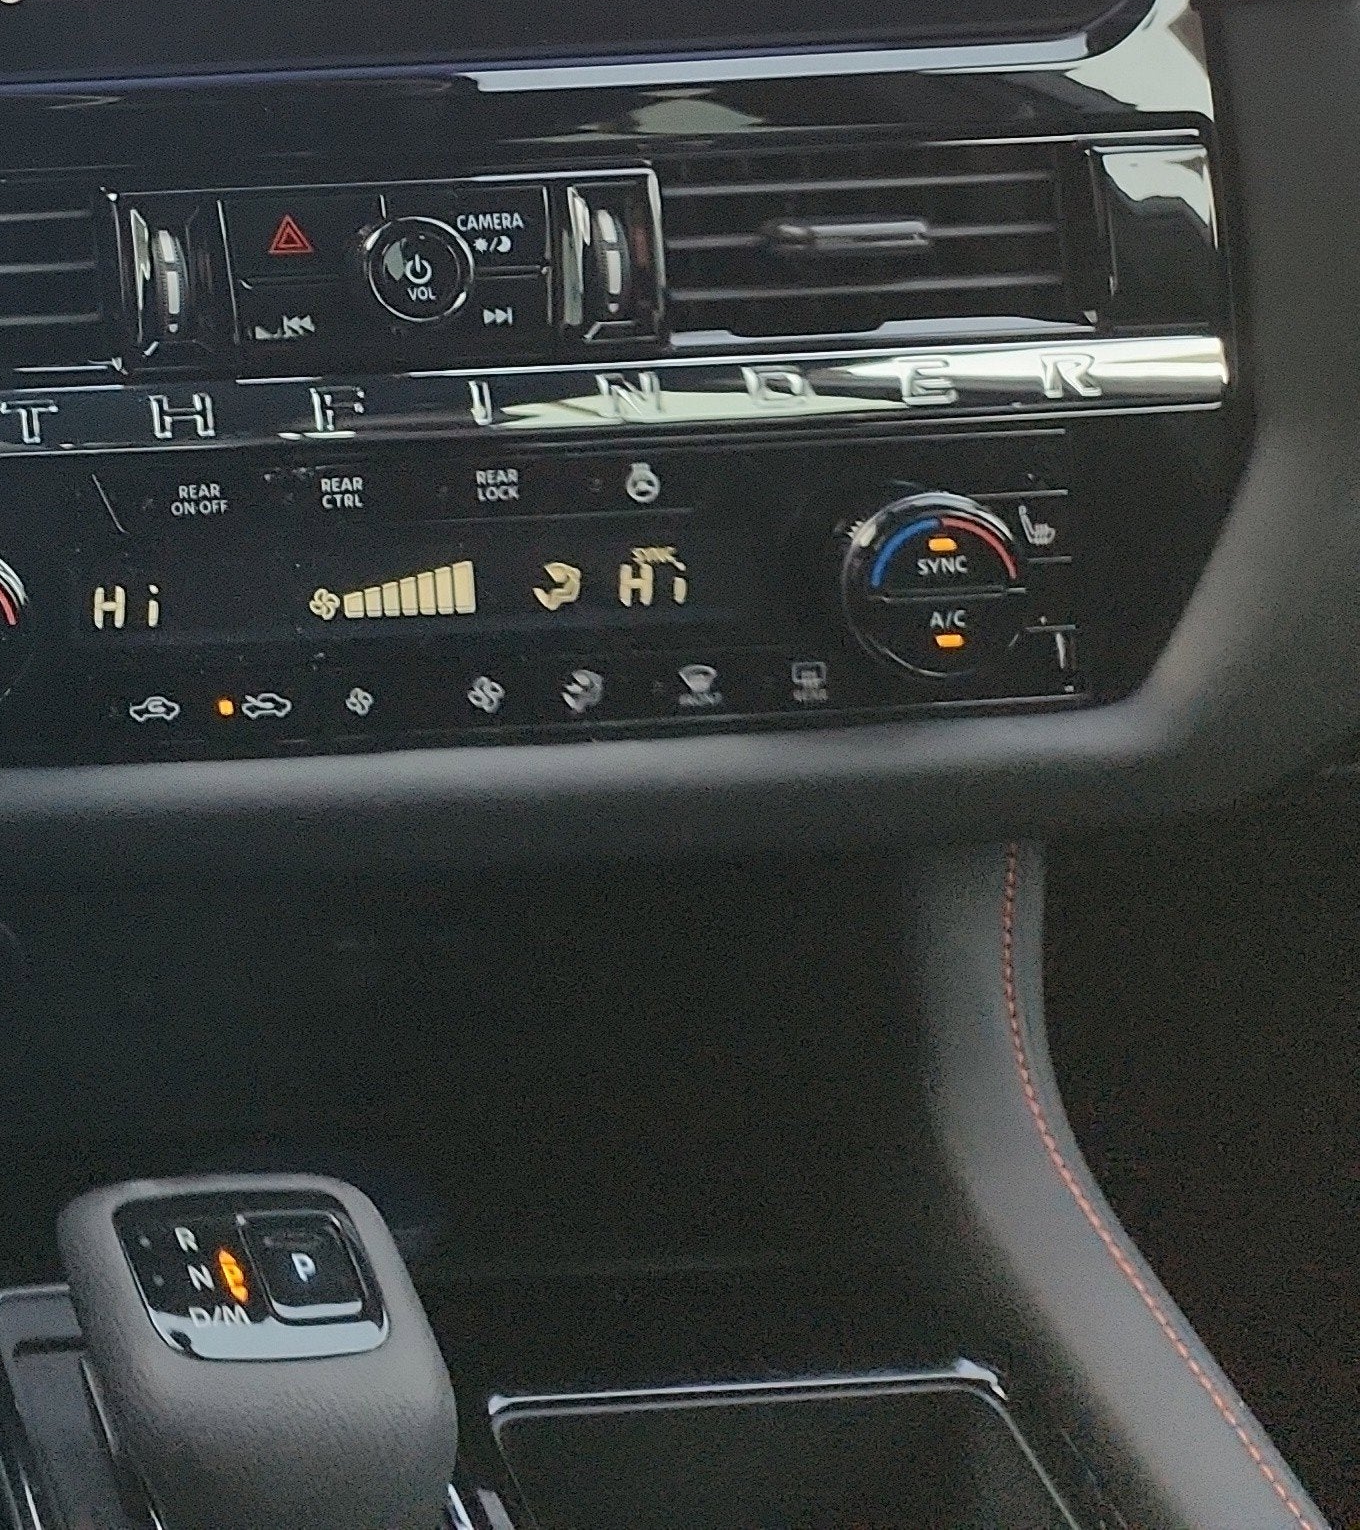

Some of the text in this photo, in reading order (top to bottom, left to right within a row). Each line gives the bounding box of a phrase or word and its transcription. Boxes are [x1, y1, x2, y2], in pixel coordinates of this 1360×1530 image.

[456, 211, 524, 231] CAMERA
[406, 286, 437, 301] VOL
[321, 477, 364, 493] REAR
[477, 469, 519, 485] REAR
[178, 484, 222, 501] REAR
[322, 492, 364, 509] CTRL
[477, 484, 520, 501] LOCK
[917, 555, 968, 576] SYNC
[930, 609, 966, 629] A/C
[174, 1226, 199, 1253] R
[291, 1252, 316, 1282] P
[188, 1264, 216, 1291] N
